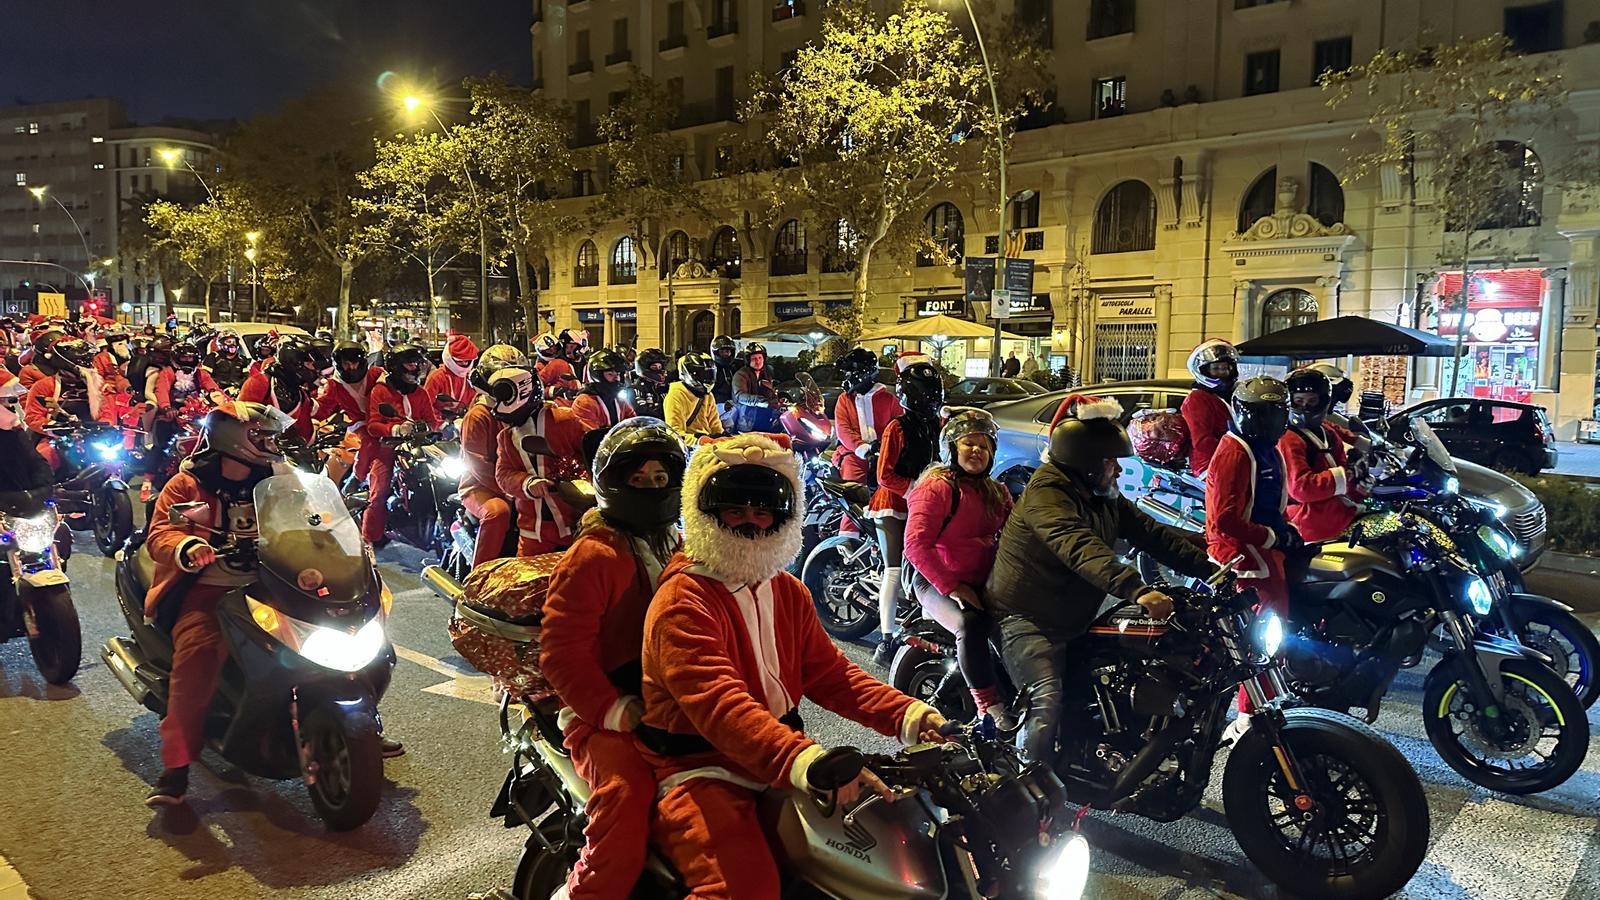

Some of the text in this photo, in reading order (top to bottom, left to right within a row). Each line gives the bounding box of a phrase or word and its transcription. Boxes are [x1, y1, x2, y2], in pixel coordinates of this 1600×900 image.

[926, 300, 955, 311] FONT
[1119, 307, 1153, 315] PARALLEL
[825, 837, 872, 864] HONDA
